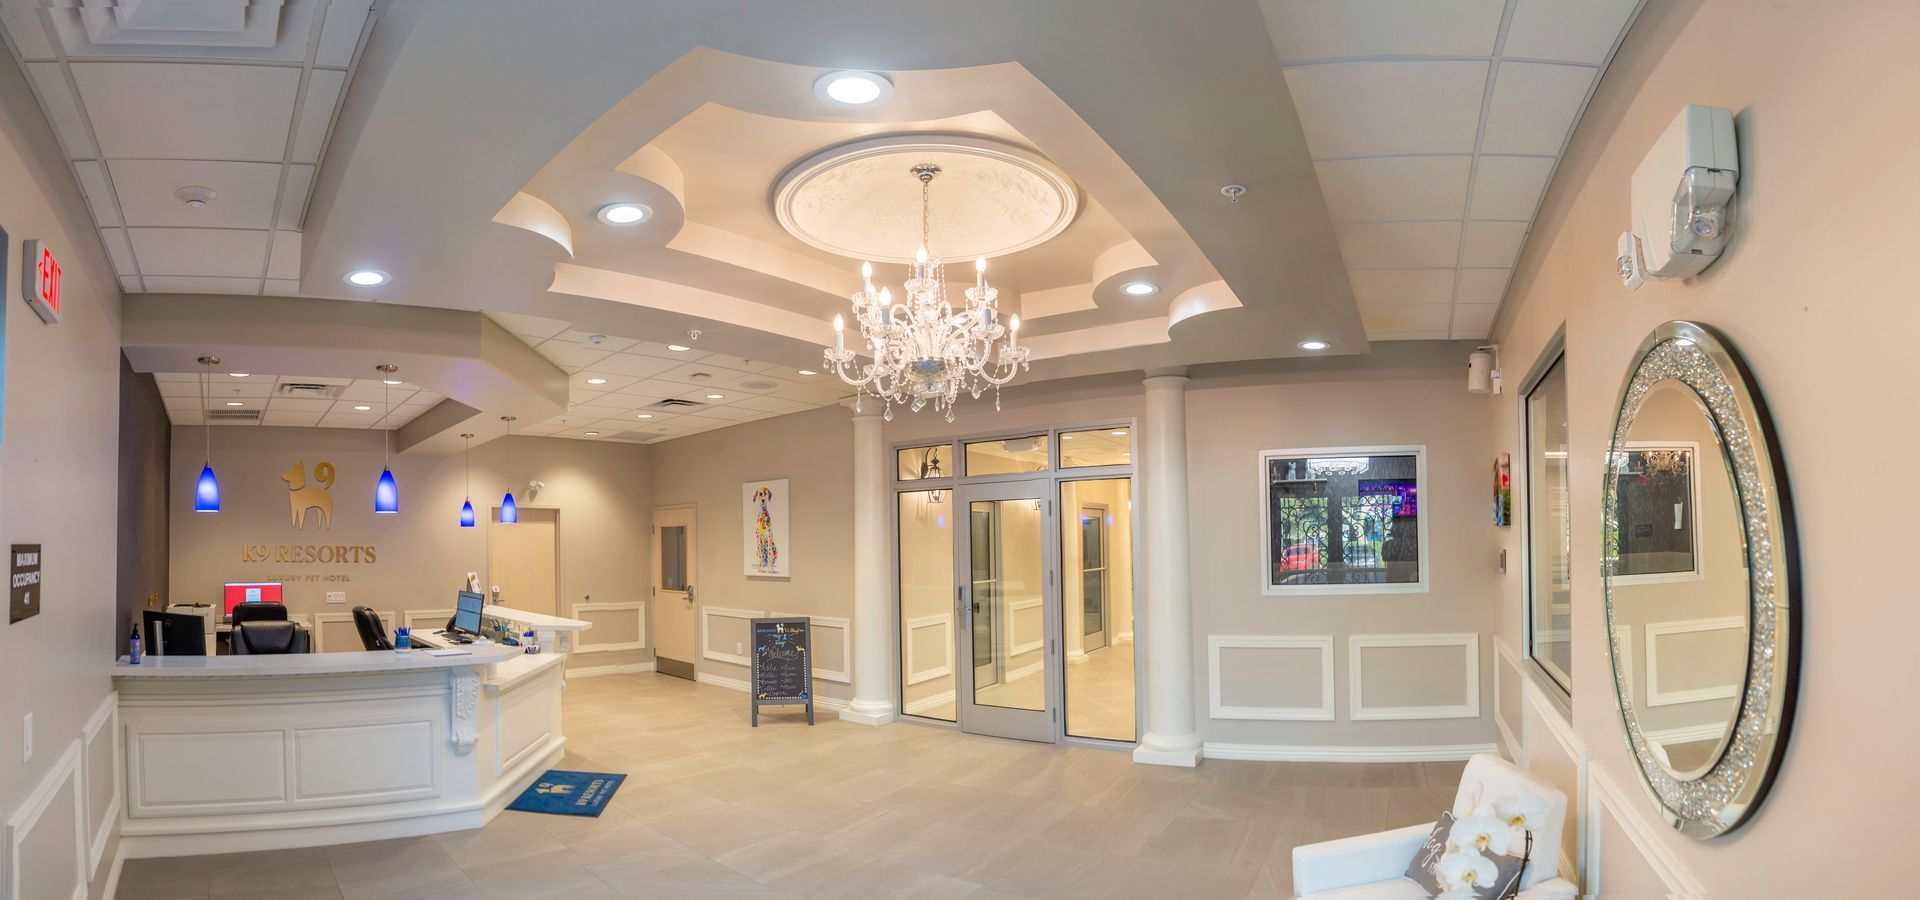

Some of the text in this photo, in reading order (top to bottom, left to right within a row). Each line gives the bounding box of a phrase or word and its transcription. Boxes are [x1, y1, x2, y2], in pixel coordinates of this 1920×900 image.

[42, 247, 62, 316] EXIT
[16, 552, 38, 566] MAXIMUM
[242, 544, 377, 564] K9 RESORTS
[12, 571, 40, 588] OCCUPANCY
